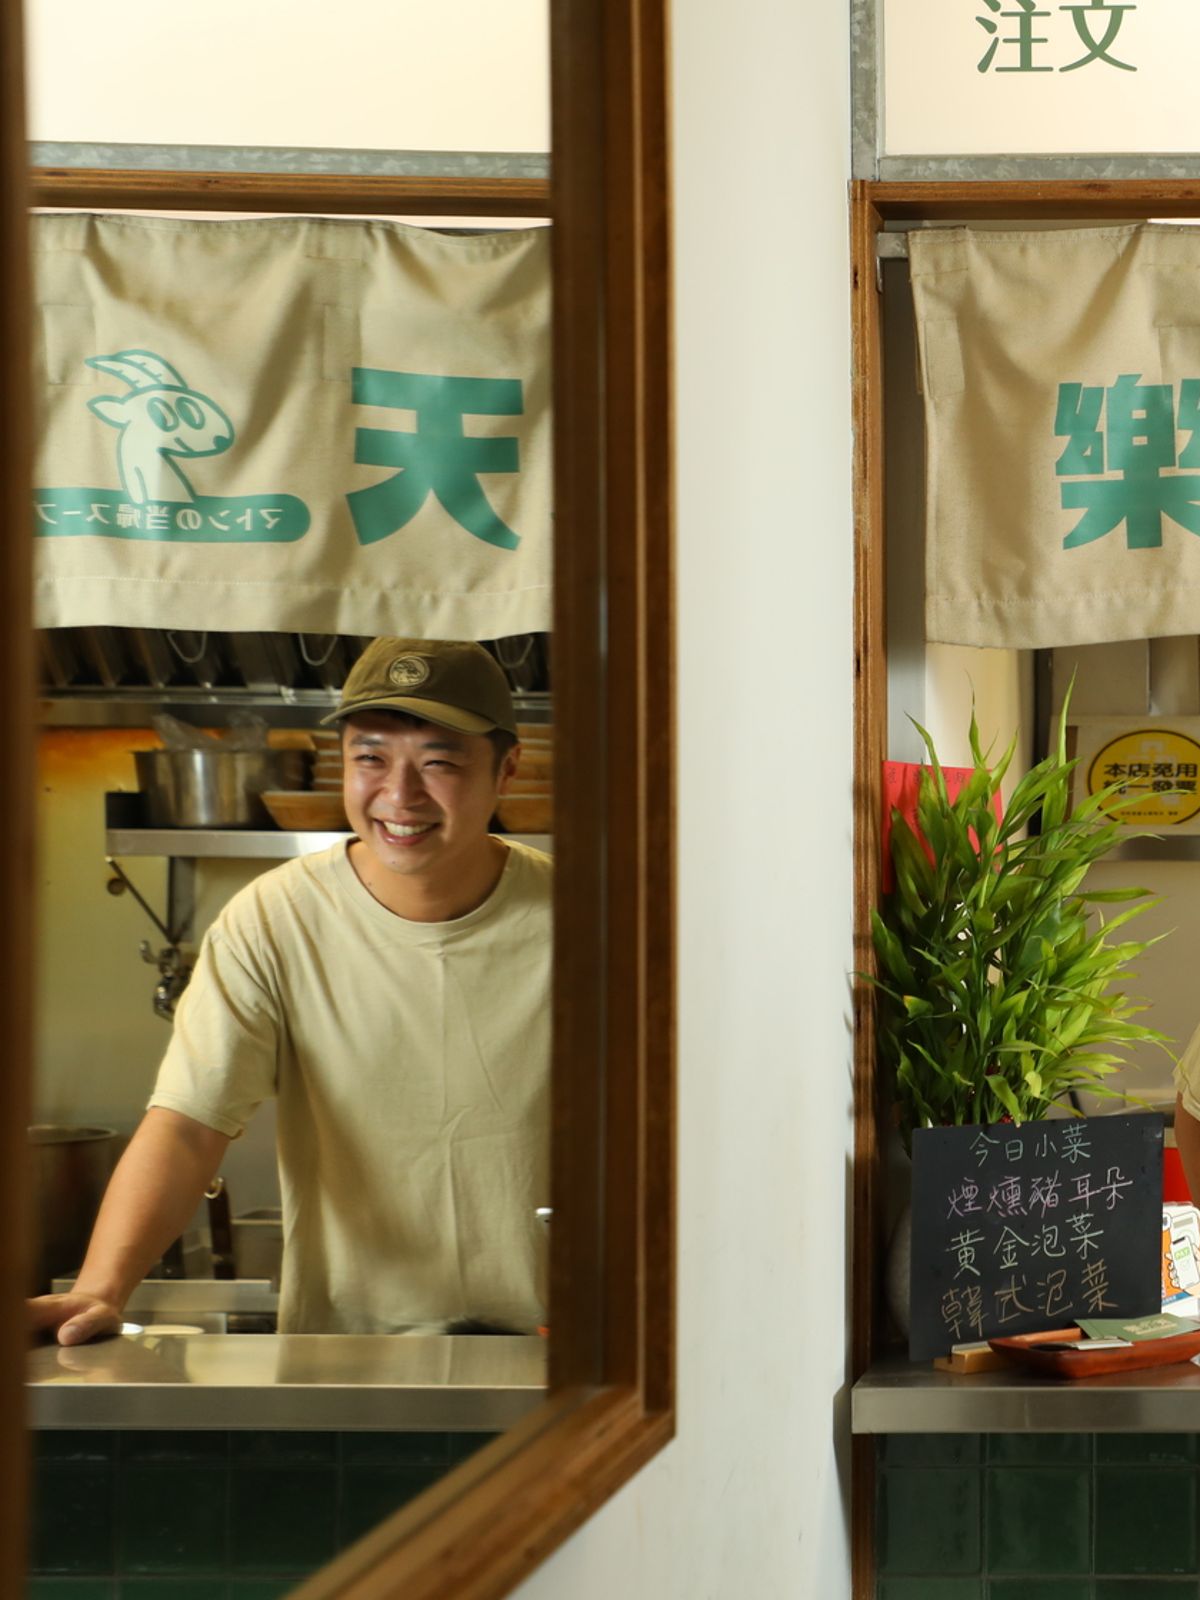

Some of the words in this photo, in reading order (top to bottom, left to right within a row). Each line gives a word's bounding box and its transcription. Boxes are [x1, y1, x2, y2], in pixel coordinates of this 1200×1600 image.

[975, 0, 1138, 74] 注文
[969, 1123, 1092, 1167] 今日小菜
[940, 1258, 1119, 1340] 韓式泡菜
